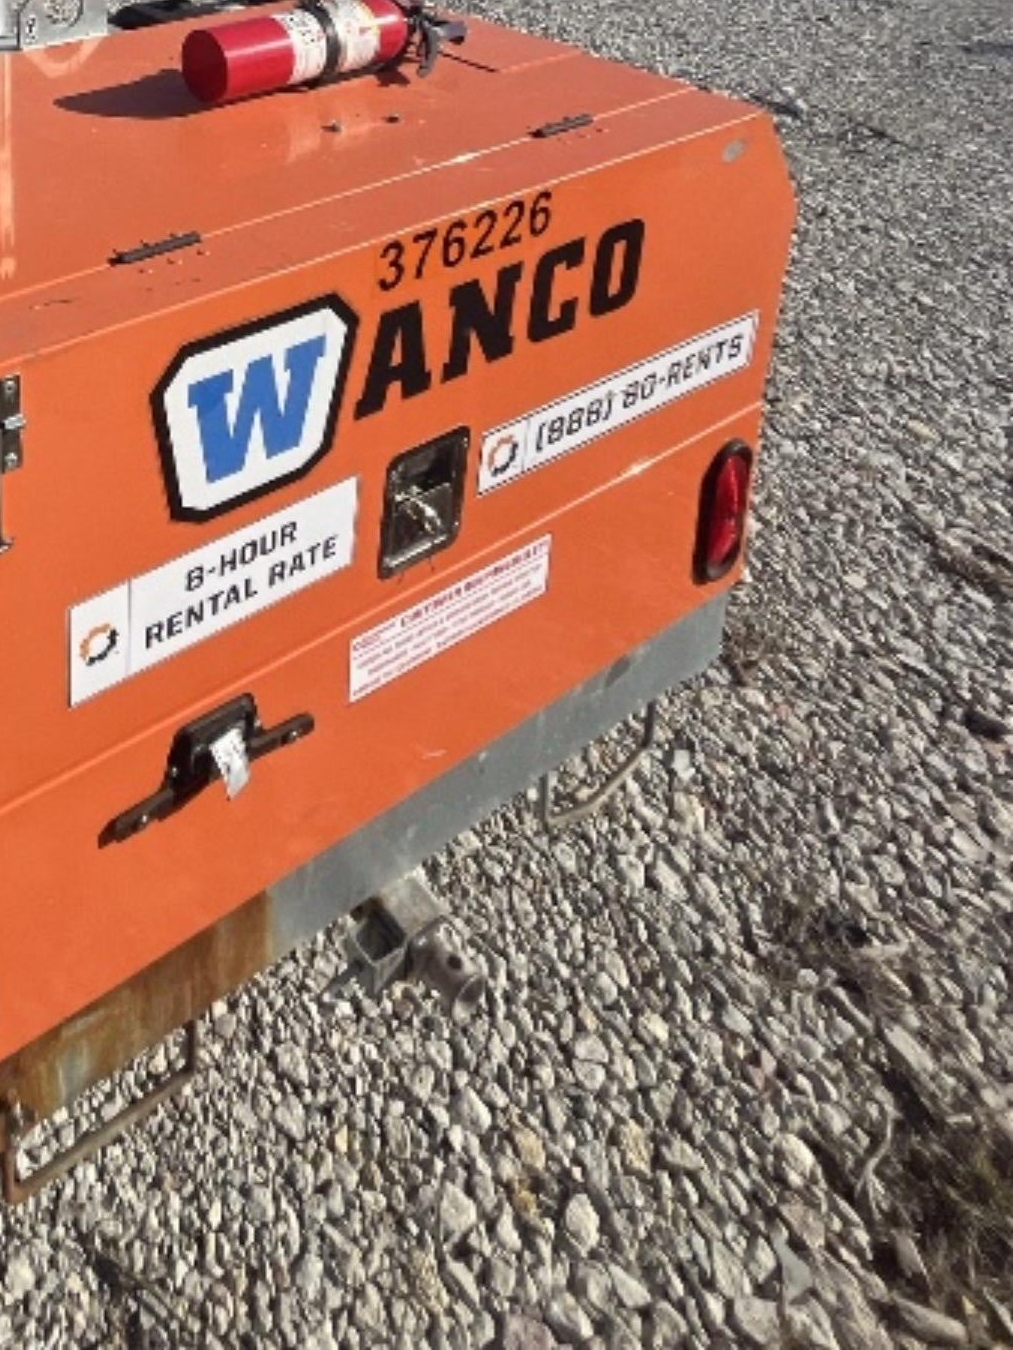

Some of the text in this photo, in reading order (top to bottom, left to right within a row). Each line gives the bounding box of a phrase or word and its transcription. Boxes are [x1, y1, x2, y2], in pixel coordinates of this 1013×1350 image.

[377, 191, 552, 292] 376226
[622, 333, 744, 409] 80-RENTS
[144, 535, 340, 650] RENTAL RATE
[185, 521, 299, 593] 8-HOUR
